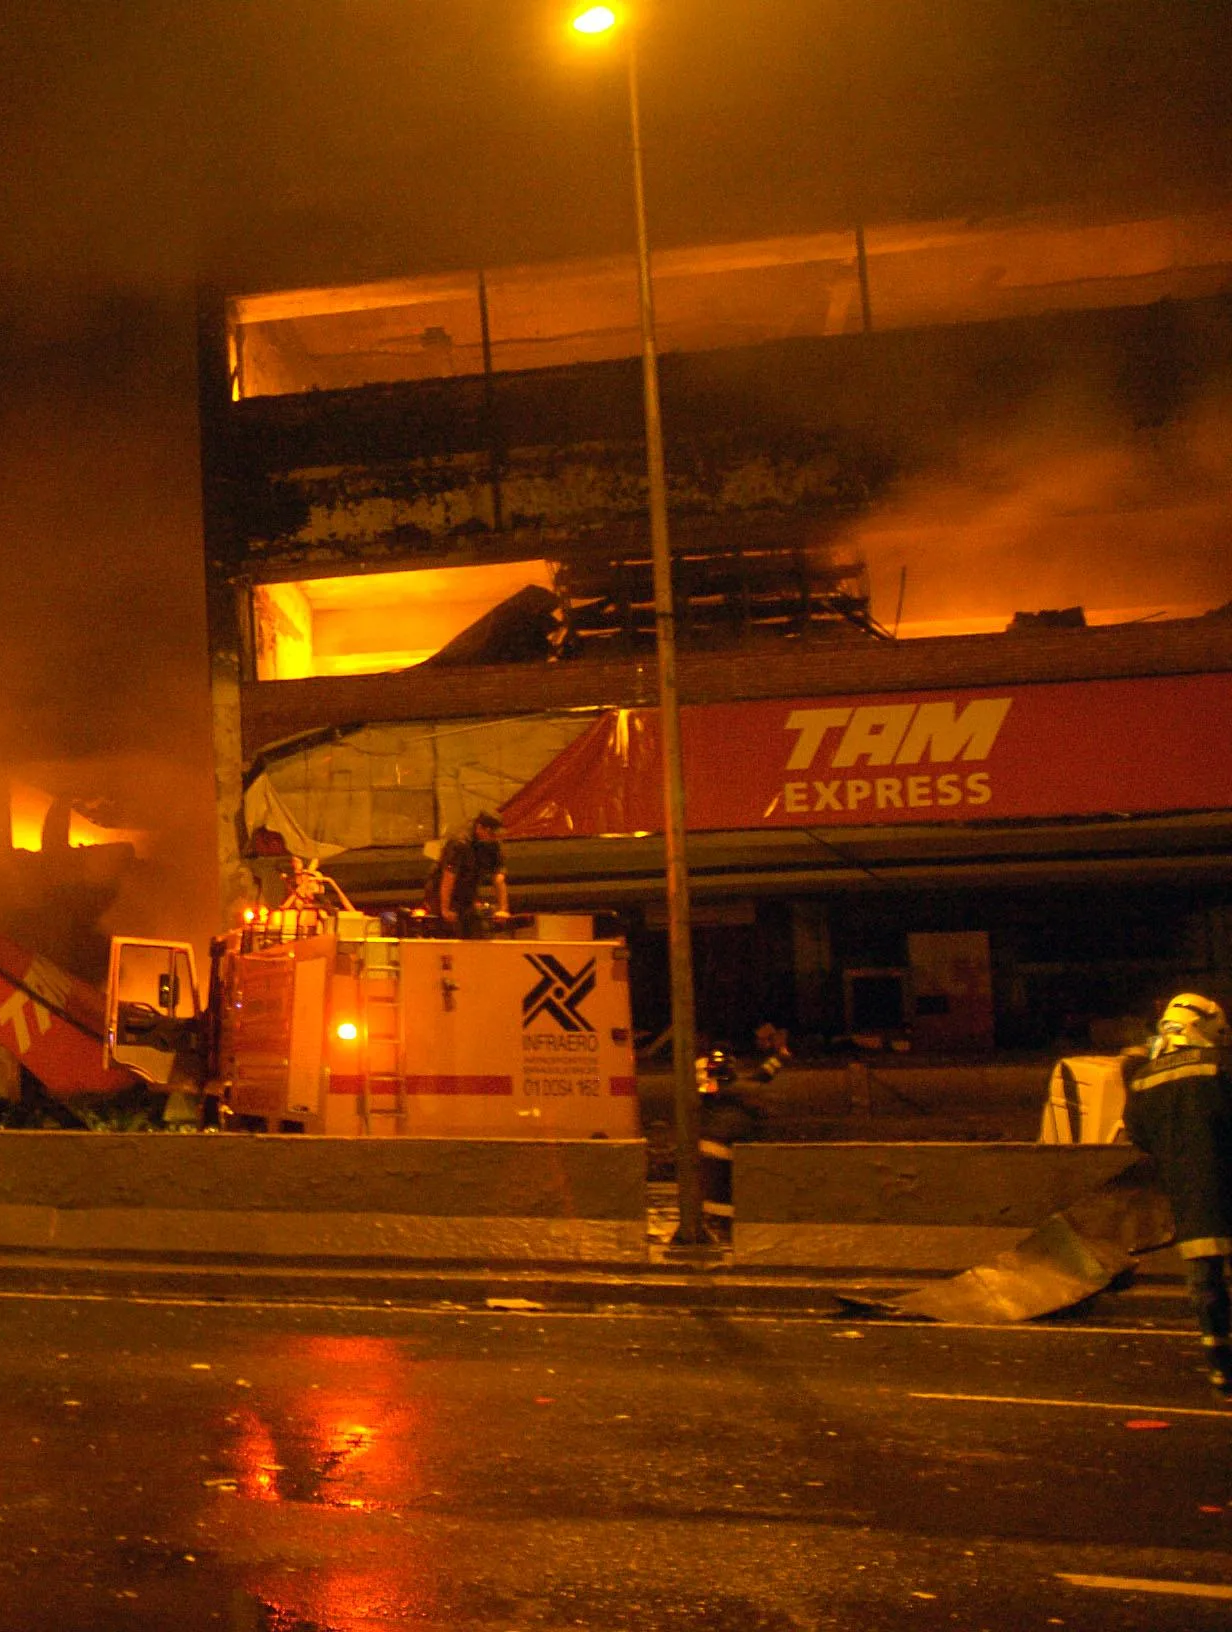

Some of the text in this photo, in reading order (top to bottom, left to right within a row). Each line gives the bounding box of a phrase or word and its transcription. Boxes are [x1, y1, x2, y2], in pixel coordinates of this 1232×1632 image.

[784, 697, 1013, 770] TAM
[784, 772, 993, 813] EXPRESS
[523, 1033, 600, 1053] INFRAERO
